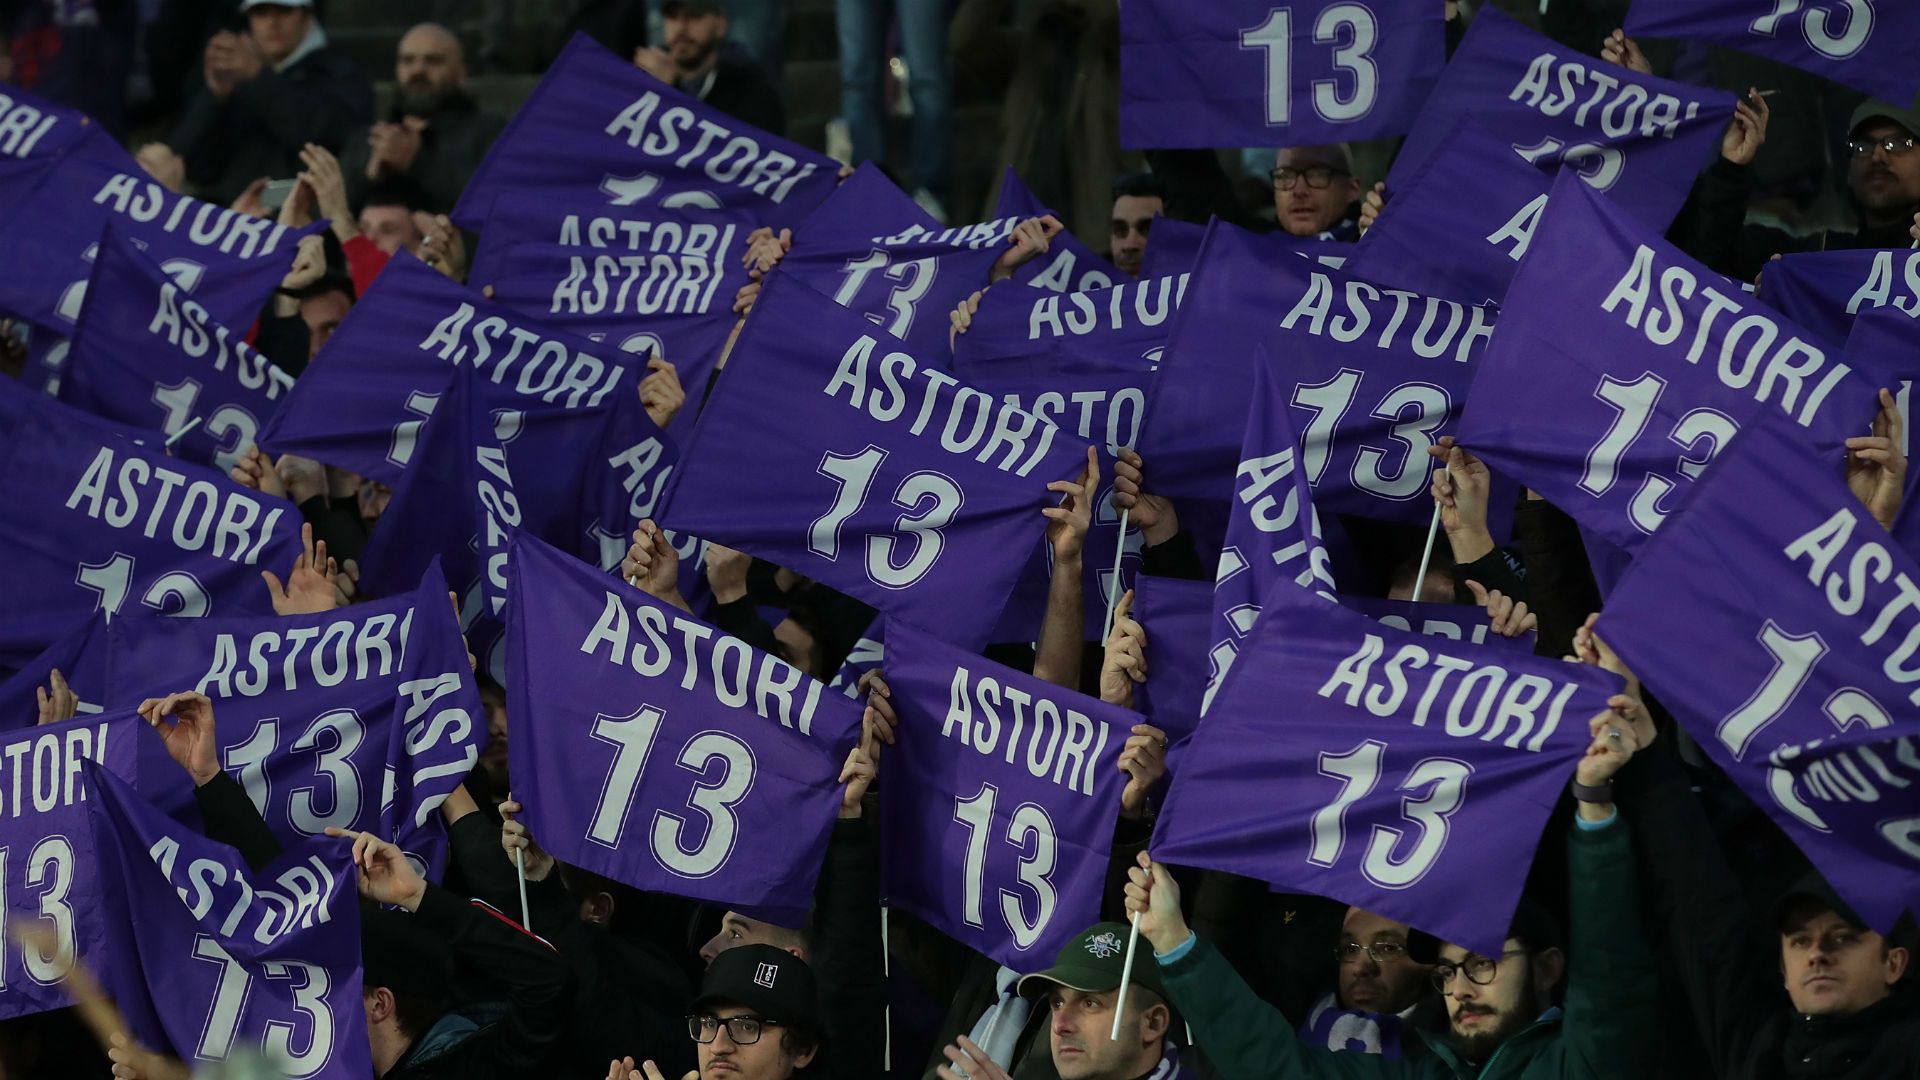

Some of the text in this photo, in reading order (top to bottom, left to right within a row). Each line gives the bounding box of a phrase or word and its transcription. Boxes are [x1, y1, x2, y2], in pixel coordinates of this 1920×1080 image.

[1238, 2, 1380, 128] 13
[605, 90, 817, 204] ASTORI
[550, 254, 724, 315] ASTORI
[1600, 244, 1852, 428] ASTORI
[420, 303, 624, 410] ASTORI
[824, 333, 1060, 478] ASTORI
[1291, 367, 1452, 501] 13
[65, 446, 284, 564] ASTORI
[807, 443, 964, 590] 13
[196, 607, 415, 698] ASTORI
[581, 591, 824, 736] ASTORI
[1318, 633, 1579, 753] ASTORI
[224, 708, 366, 838] 13
[585, 703, 757, 879] 13
[942, 667, 1110, 796] ASTORI
[953, 781, 1058, 951] 13
[1306, 739, 1475, 889] 13
[192, 933, 336, 1080] 13
